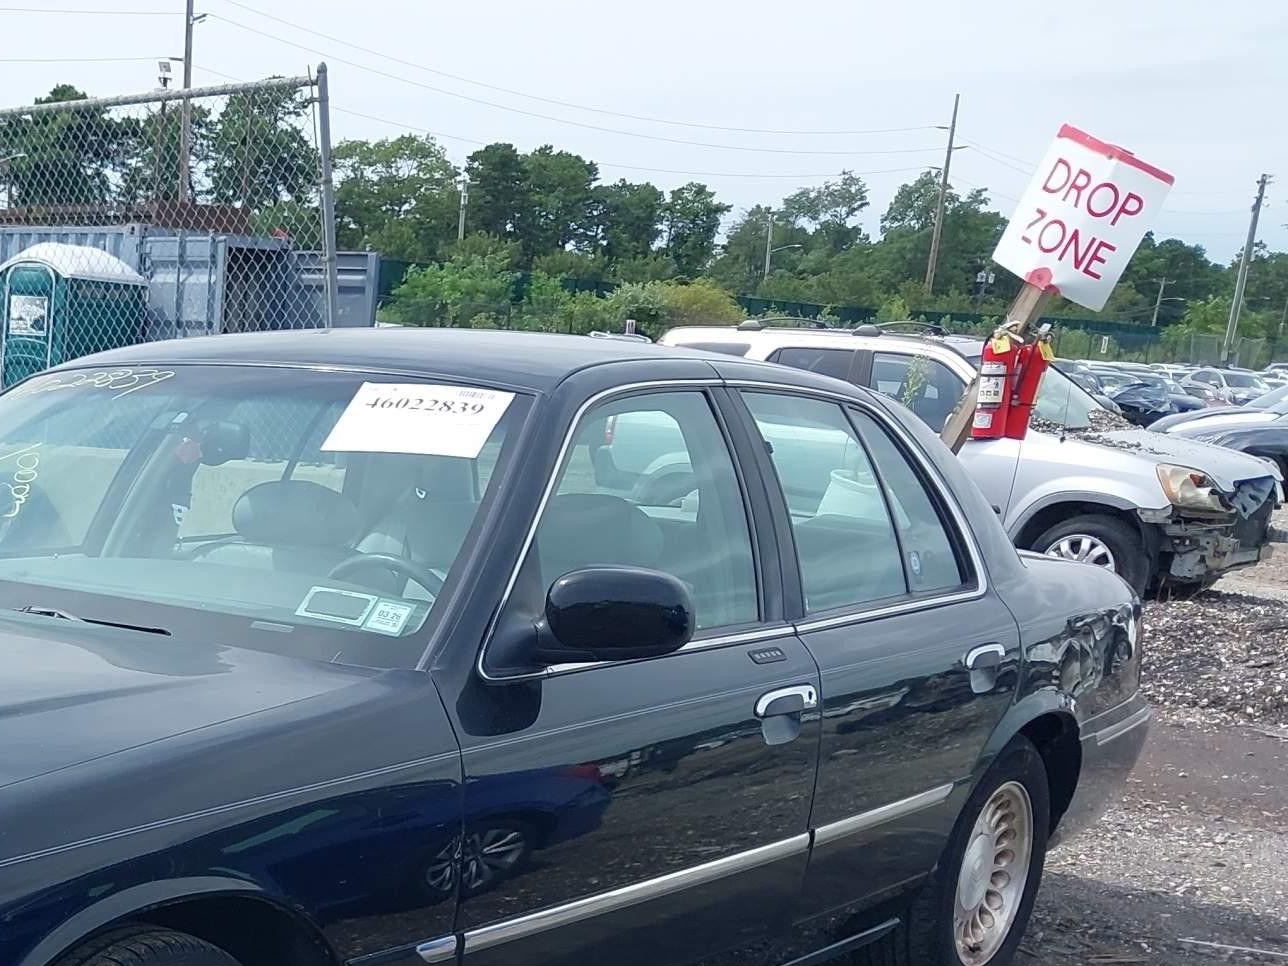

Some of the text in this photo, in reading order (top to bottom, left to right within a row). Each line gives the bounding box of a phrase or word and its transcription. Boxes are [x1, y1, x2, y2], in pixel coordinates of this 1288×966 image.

[1042, 157, 1144, 227] DROP
[1021, 207, 1117, 280] ZONE
[365, 396, 485, 416] 46022839
